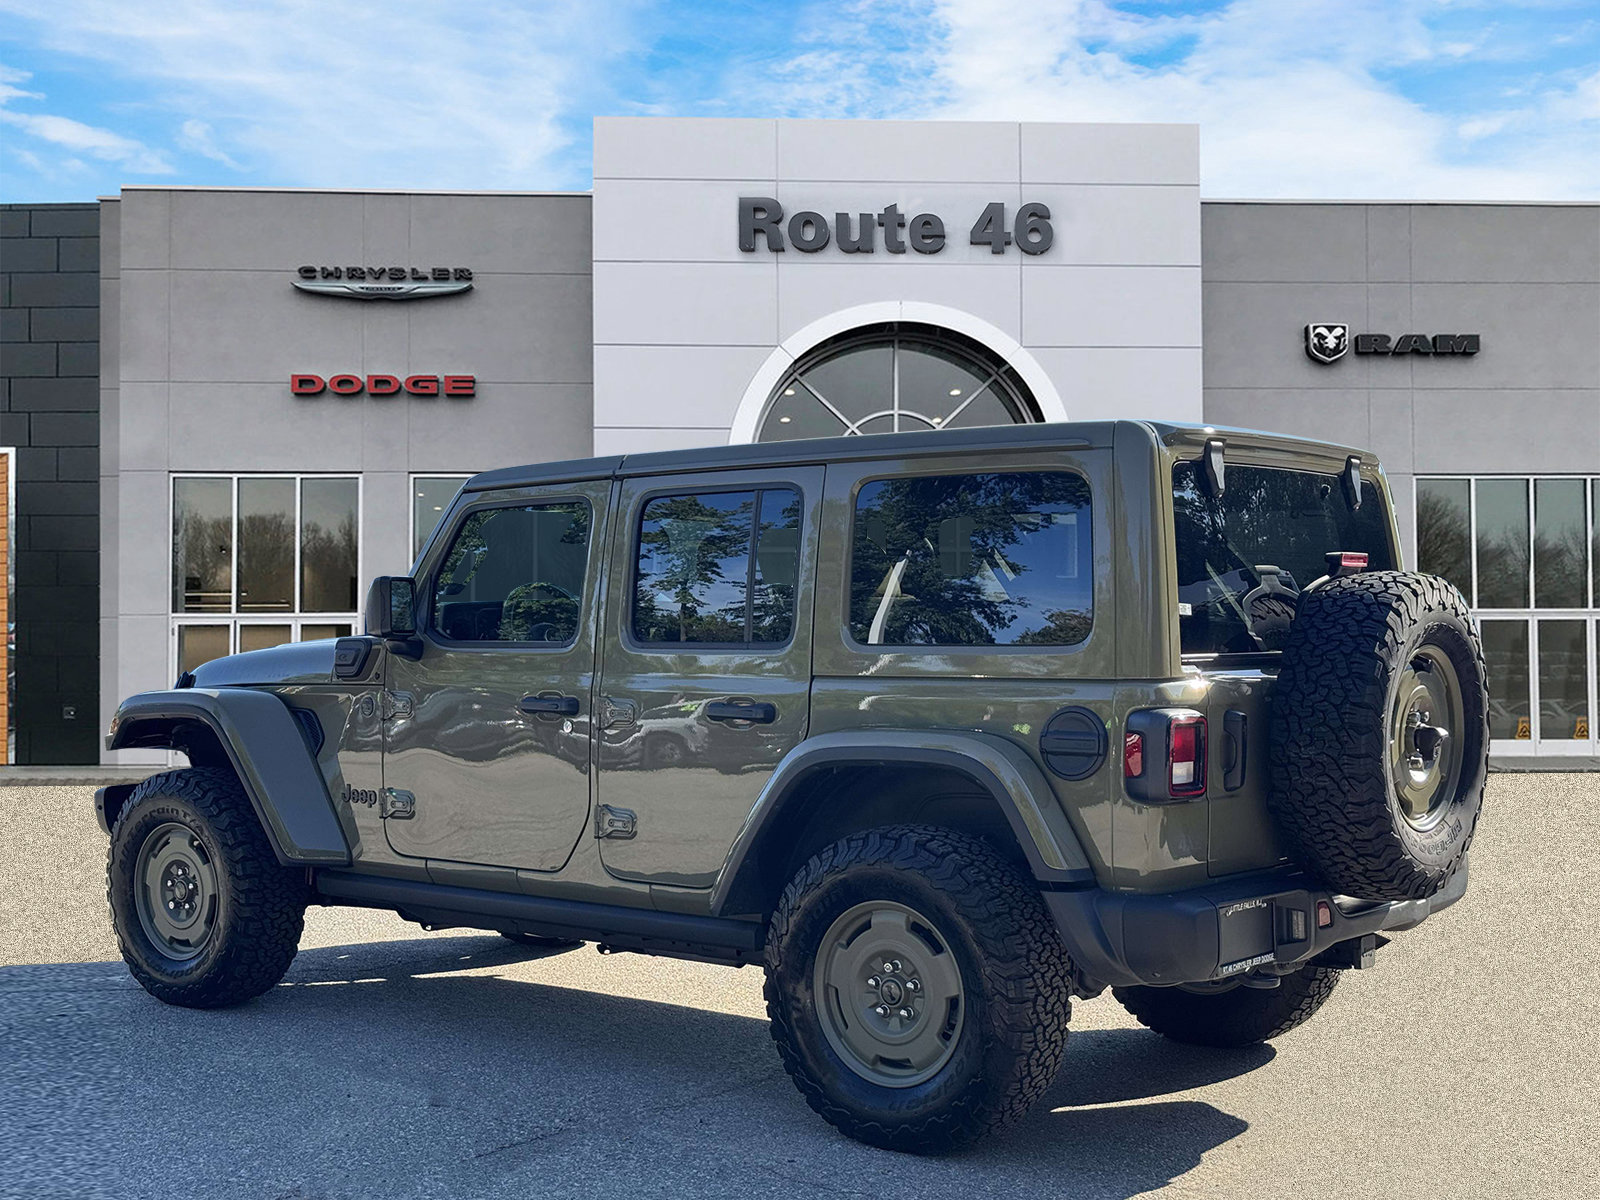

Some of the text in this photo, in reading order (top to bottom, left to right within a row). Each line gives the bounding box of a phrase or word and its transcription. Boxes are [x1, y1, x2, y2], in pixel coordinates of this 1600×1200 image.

[738, 197, 1054, 255] Route 46
[298, 266, 473, 281] CHRYSLER
[1354, 334, 1480, 355] RAM
[291, 374, 475, 397] DODGE
[341, 783, 379, 809] Jeep
